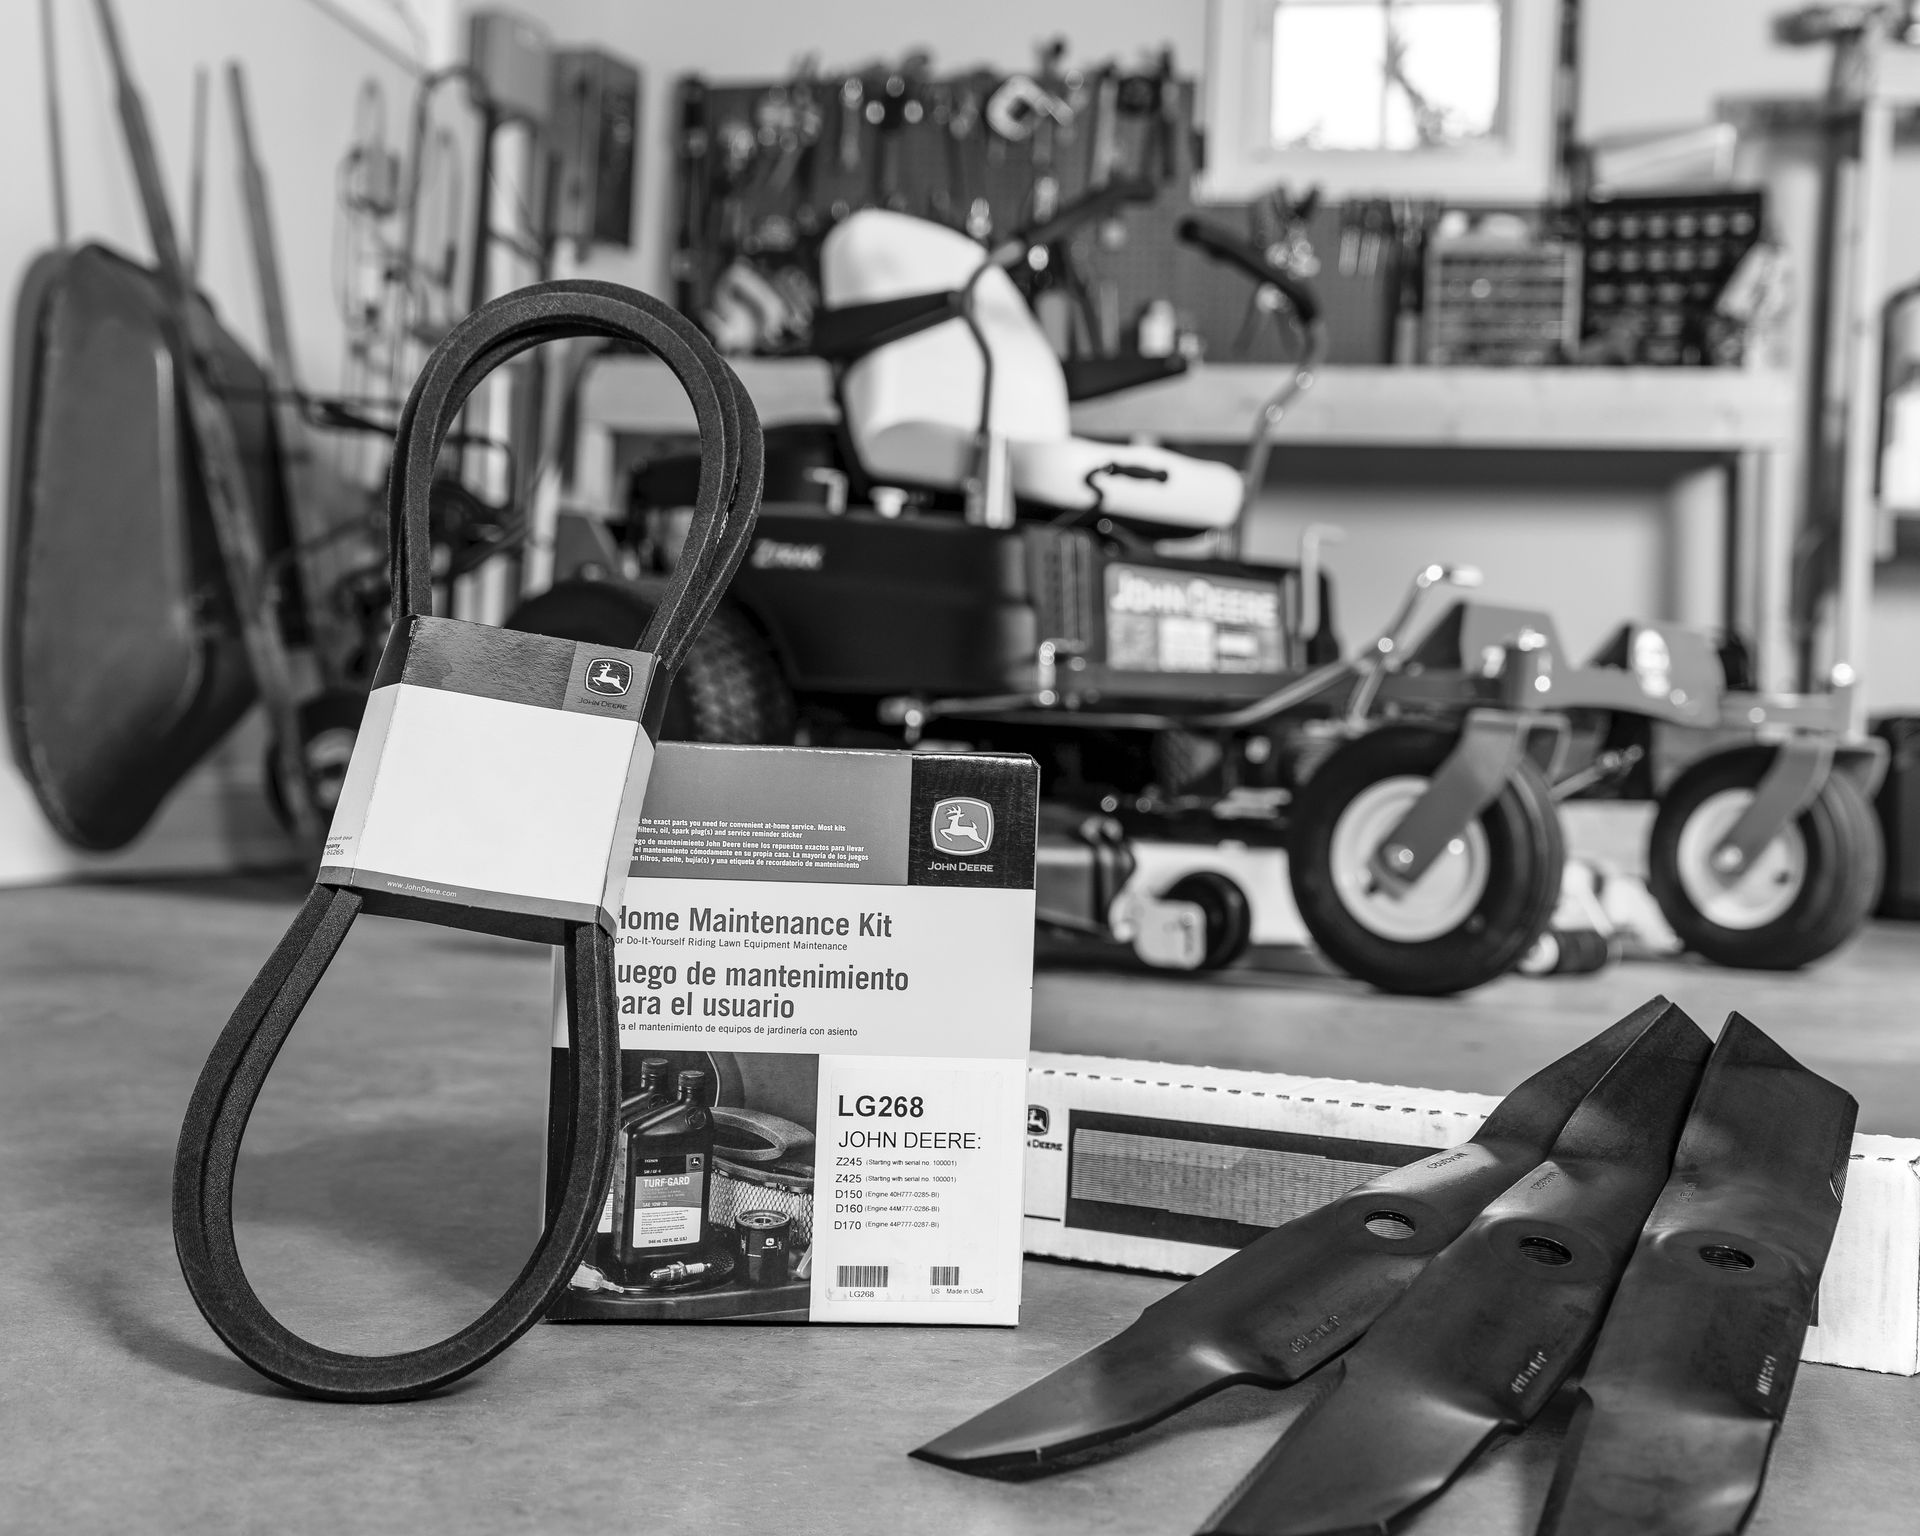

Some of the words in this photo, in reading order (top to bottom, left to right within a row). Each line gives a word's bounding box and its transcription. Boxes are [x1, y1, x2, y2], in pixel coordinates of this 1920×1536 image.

[578, 698, 600, 706] JOHN
[601, 701, 628, 710] DEERE
[638, 826, 658, 834] filters,
[690, 848, 733, 856] cómodamente
[802, 852, 826, 860] mayoría
[848, 853, 868, 861] juegos
[730, 858, 754, 866] etiqueta
[928, 862, 957, 871] JOHN
[959, 862, 994, 872] DEERE
[387, 881, 457, 898] www.JohnDeere.com
[689, 907, 849, 936] Maintenance
[859, 912, 892, 938] Kit
[627, 936, 685, 947] Do-It-Yourself
[688, 938, 716, 949] Riding
[719, 939, 741, 948] Lawn
[744, 940, 790, 950] Equipment
[794, 941, 848, 951] Maintenance
[618, 964, 677, 990] uego
[687, 961, 716, 985] de
[726, 964, 909, 991] mantenimiento
[671, 992, 693, 1016] el
[703, 994, 795, 1018] usuario
[628, 1022, 636, 1032] el
[639, 1023, 703, 1032] mantenimiento
[706, 1024, 716, 1033] de
[719, 1025, 751, 1035] equipos
[754, 1025, 765, 1034] de
[767, 1025, 806, 1036] jardinería
[810, 1028, 825, 1036] con
[827, 1027, 858, 1036] asiento
[838, 1095, 924, 1118] LG268
[838, 1131, 897, 1148] JOHN
[904, 1132, 982, 1149] DEERE:
[1033, 1139, 1063, 1151] DEERE
[836, 1157, 862, 1166] Z245
[644, 1176, 690, 1188] TURF-GARD
[836, 1174, 862, 1183] Z425
[836, 1190, 862, 1199] D150
[836, 1204, 863, 1213] D160
[834, 1221, 862, 1230] D170
